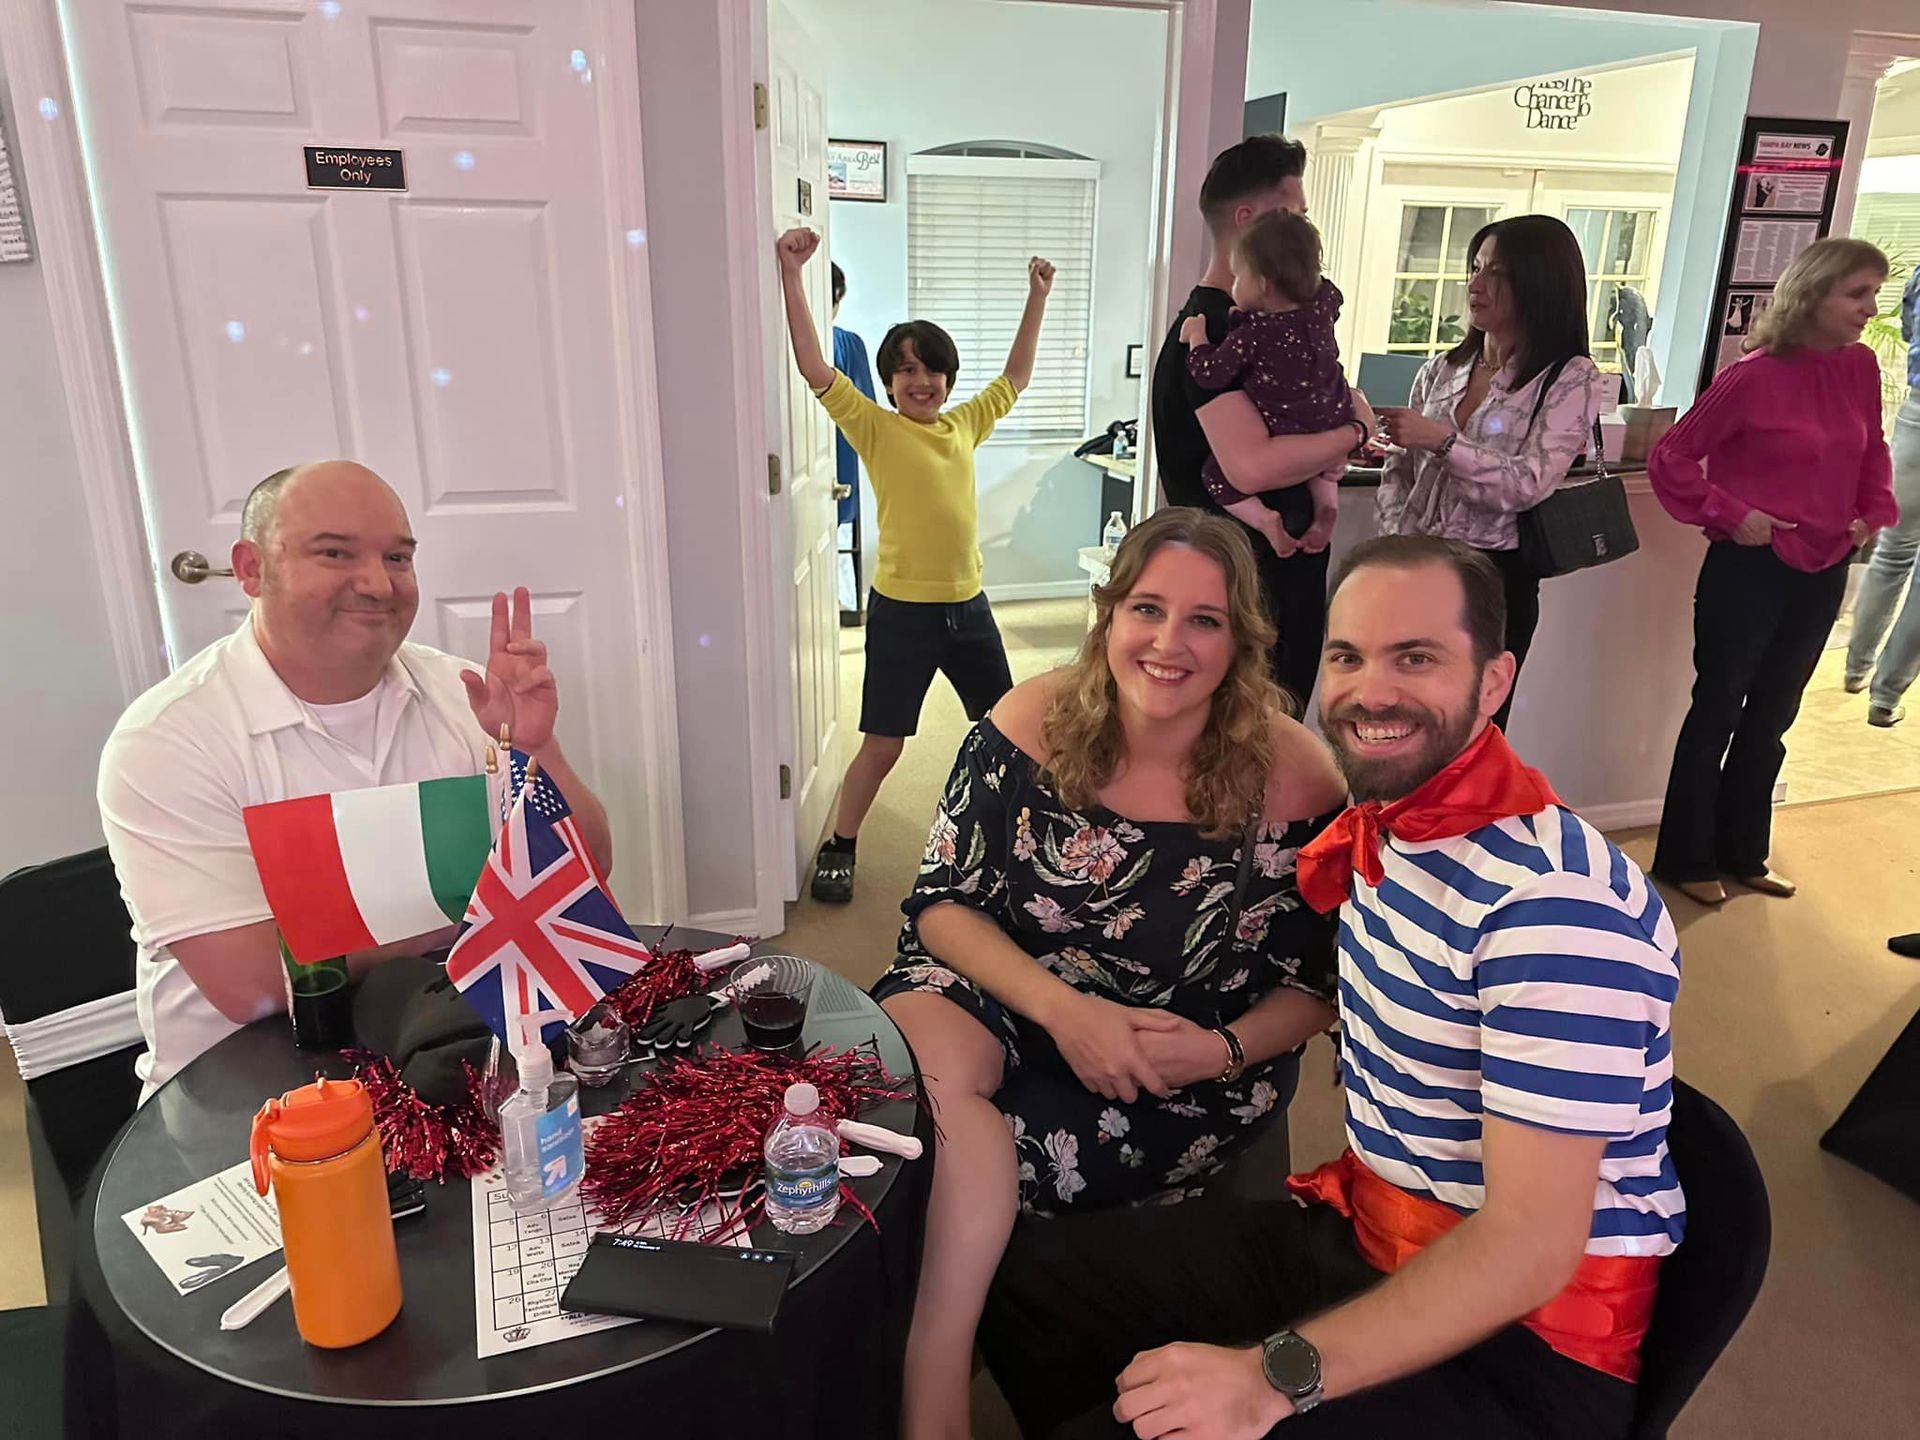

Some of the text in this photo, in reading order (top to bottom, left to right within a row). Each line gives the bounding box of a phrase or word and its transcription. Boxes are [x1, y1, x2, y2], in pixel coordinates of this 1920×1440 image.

[1514, 84, 1576, 110] Chance
[1527, 107, 1578, 130] Dance
[1793, 143, 1812, 151] NEWS
[315, 151, 393, 168] Employees
[340, 168, 372, 184] Only
[777, 1178, 832, 1197] Zephyrhills
[612, 1238, 634, 1248] 7:49
[508, 1297, 521, 1305] 26
[545, 1289, 556, 1297] 27
